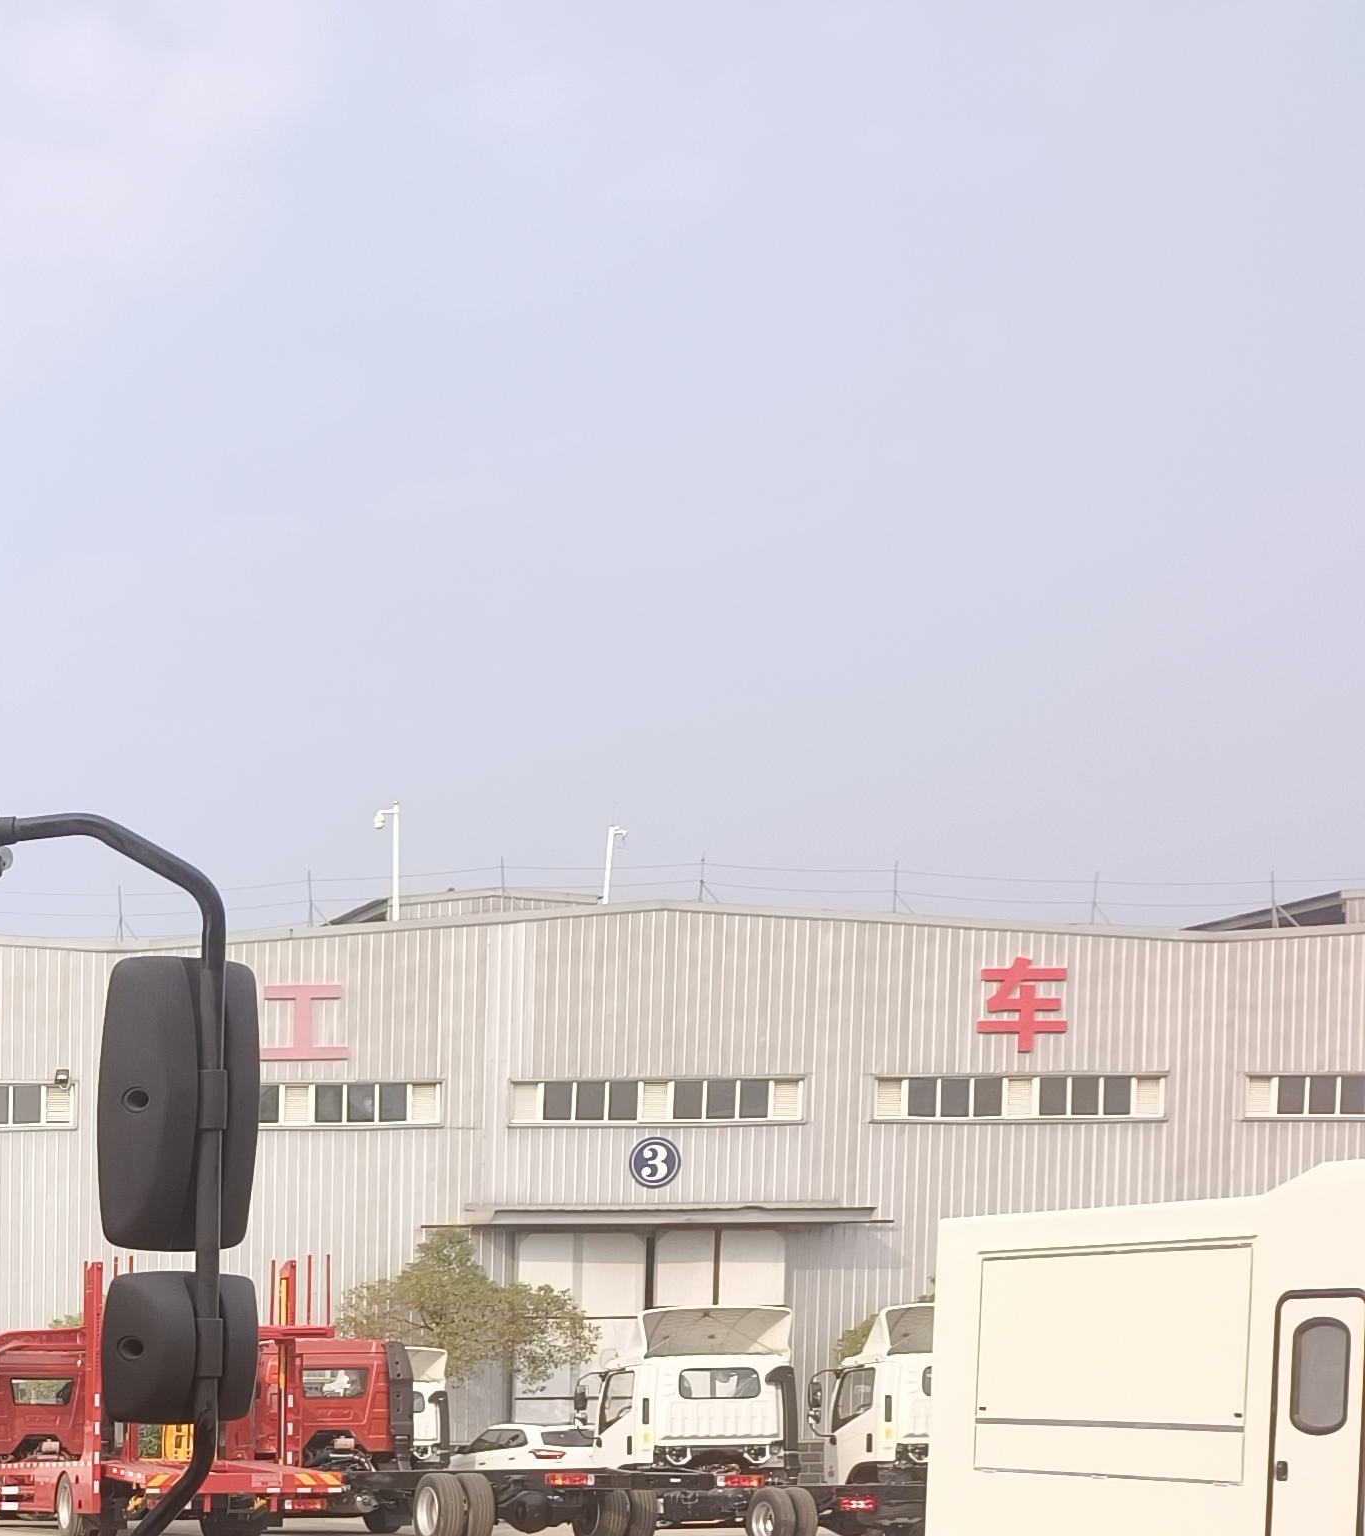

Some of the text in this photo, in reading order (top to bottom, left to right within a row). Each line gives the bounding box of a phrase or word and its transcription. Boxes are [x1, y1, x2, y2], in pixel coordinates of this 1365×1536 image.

[259, 956, 1068, 1062] 工 车
[640, 1144, 669, 1181] 3
